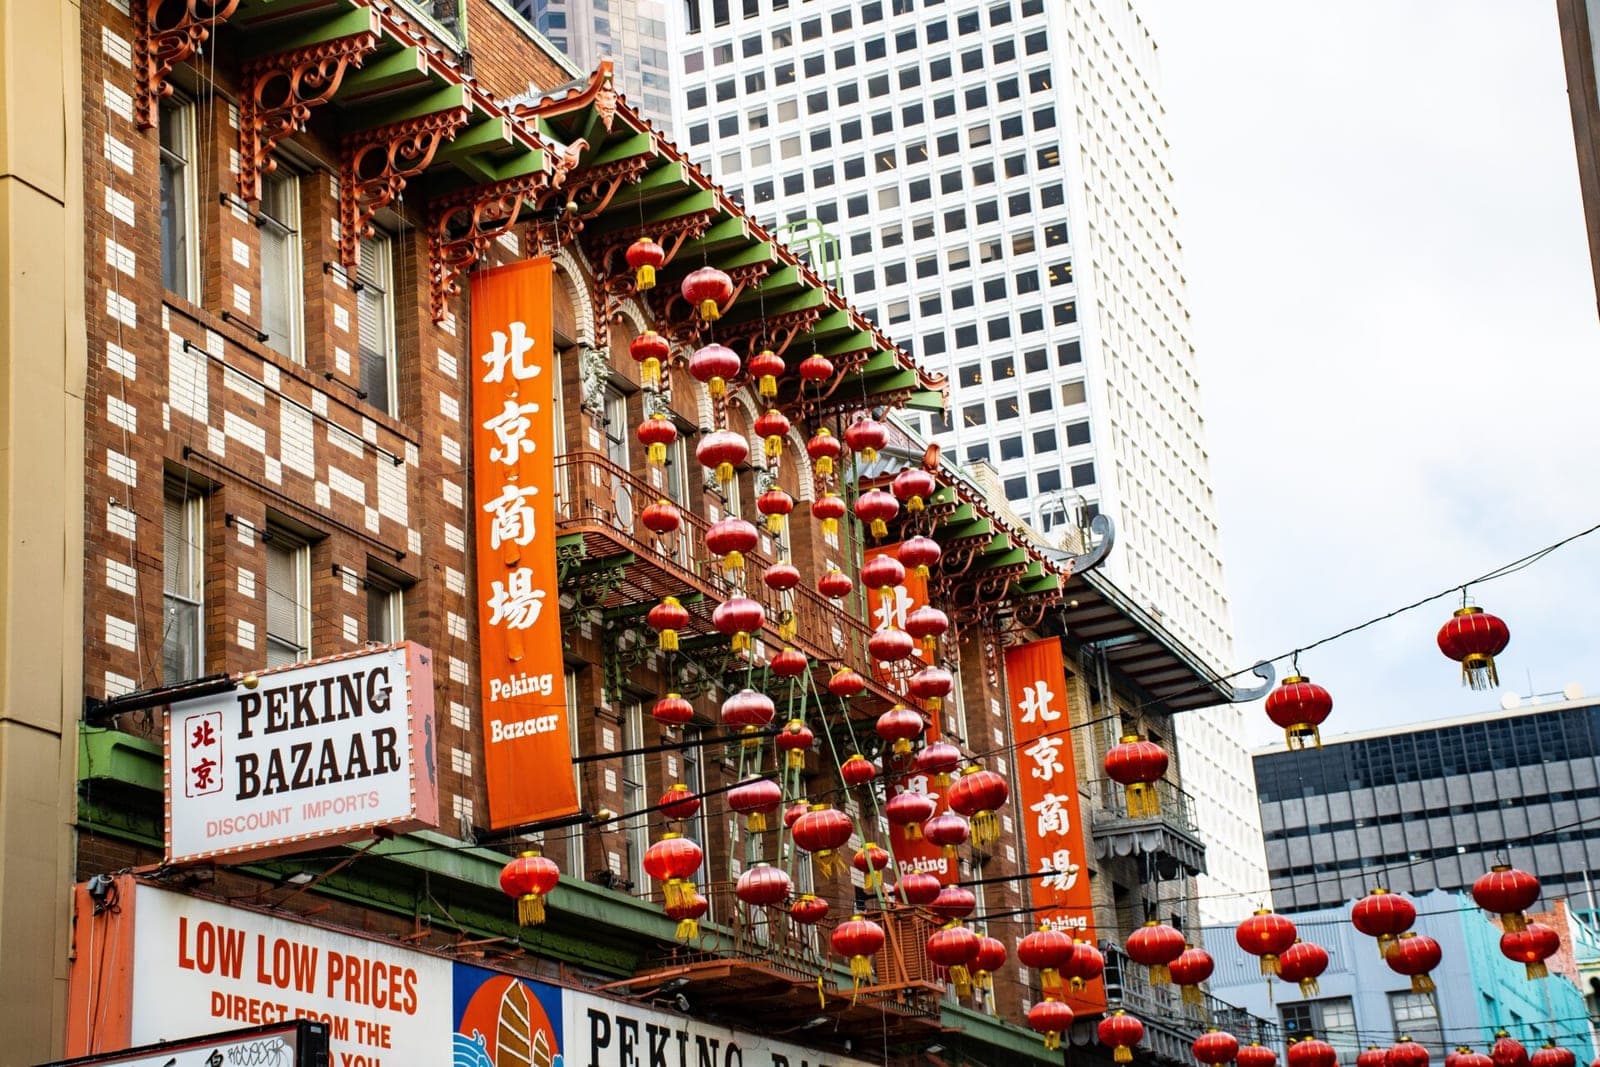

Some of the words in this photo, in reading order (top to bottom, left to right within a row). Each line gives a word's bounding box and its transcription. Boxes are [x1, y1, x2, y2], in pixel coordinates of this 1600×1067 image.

[481, 321, 546, 630] 北京商場
[237, 667, 393, 740] PEKING
[490, 672, 553, 702] Peking
[191, 720, 217, 789] 北京
[490, 714, 559, 743] Bazaar
[235, 726, 401, 801] BAZAAR
[1018, 680, 1079, 890] 北京商場
[206, 807, 293, 838] DISCOUNT
[302, 791, 380, 821] IMPORTS
[899, 856, 948, 875] Peking
[178, 917, 246, 980] LOW
[257, 934, 319, 994] LOW
[327, 951, 418, 1015] PRICES
[211, 991, 288, 1025] DIRECT
[355, 1020, 392, 1049] THE
